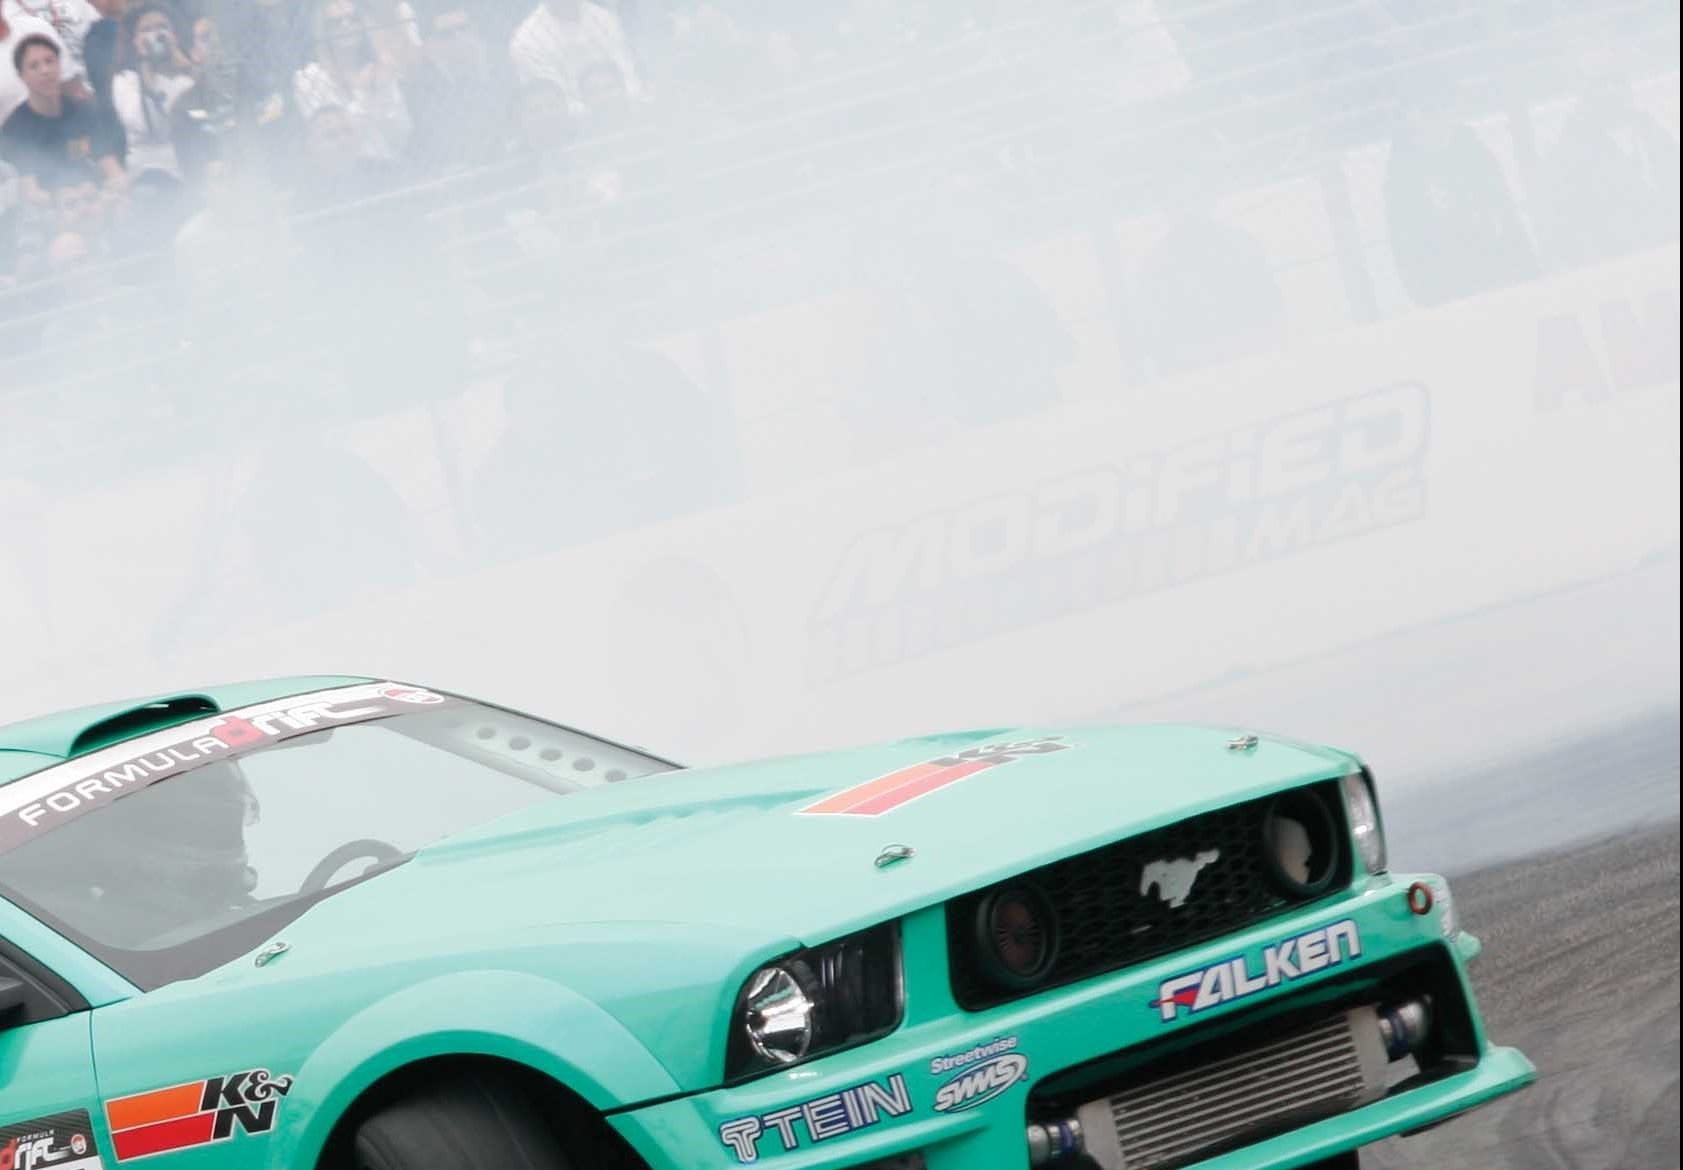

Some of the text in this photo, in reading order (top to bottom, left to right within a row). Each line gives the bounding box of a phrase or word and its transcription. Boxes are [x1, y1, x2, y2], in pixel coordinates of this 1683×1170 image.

[18, 736, 229, 827] FORMULA
[1158, 918, 1362, 1021] FALKEN
[761, 1073, 913, 1150] TEIN
